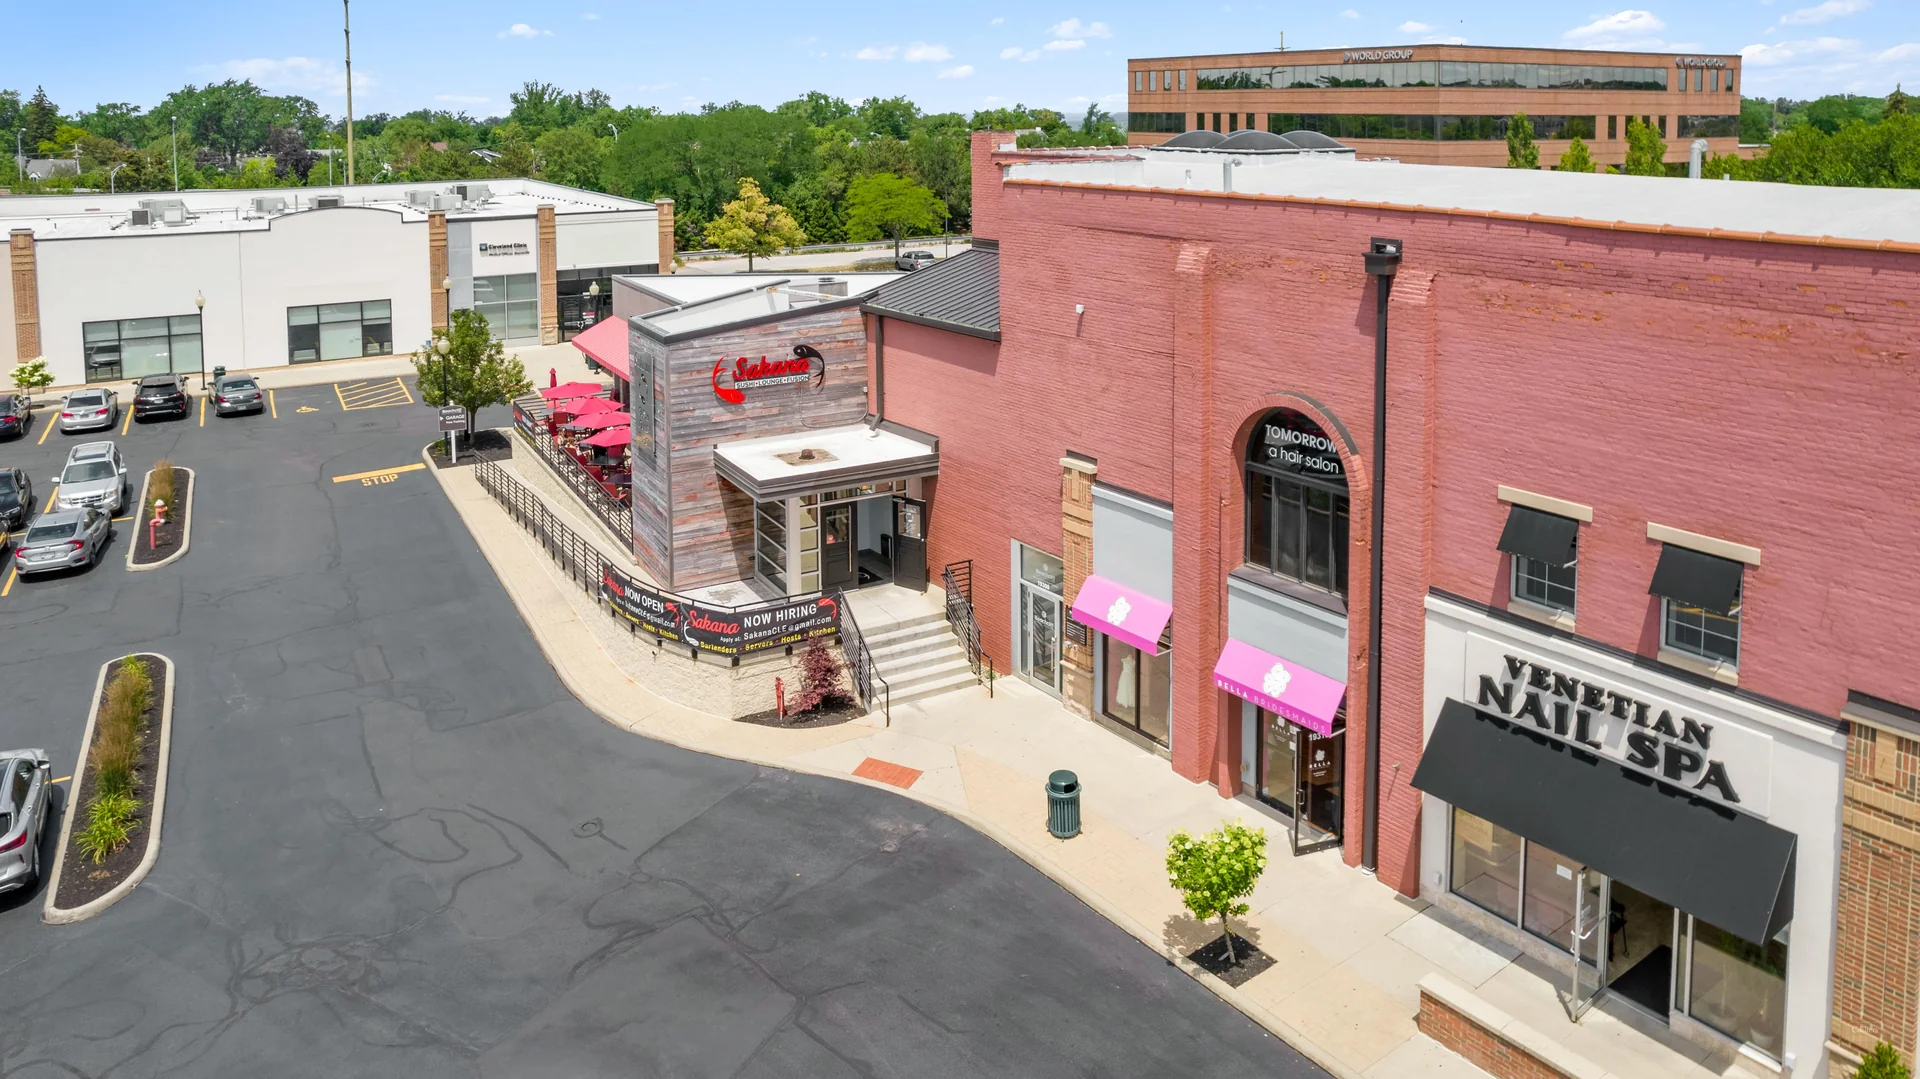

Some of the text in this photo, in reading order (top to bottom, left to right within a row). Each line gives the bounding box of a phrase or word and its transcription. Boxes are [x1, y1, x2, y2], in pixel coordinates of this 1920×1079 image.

[1352, 49, 1413, 60] WORLD GROUP
[732, 355, 811, 381] Sakana
[736, 375, 810, 389] SUSHI LOUNGE FUSION
[1265, 424, 1337, 453] TOMORROW
[1268, 446, 1339, 474] a hair salon
[361, 473, 399, 487] STOP
[624, 585, 664, 614] NOW OPEN
[688, 610, 741, 635] Sakana
[744, 604, 818, 629] NOW HIRING
[659, 628, 679, 641] Kitchen
[700, 641, 737, 654] Bartenders
[745, 640, 774, 651] Servers
[781, 633, 802, 643] Hosts
[1217, 680, 1326, 734] BELLA BRIDESMAIDS
[1503, 654, 1714, 750] VENETIAN
[1478, 674, 1741, 804] NAIL SPA
